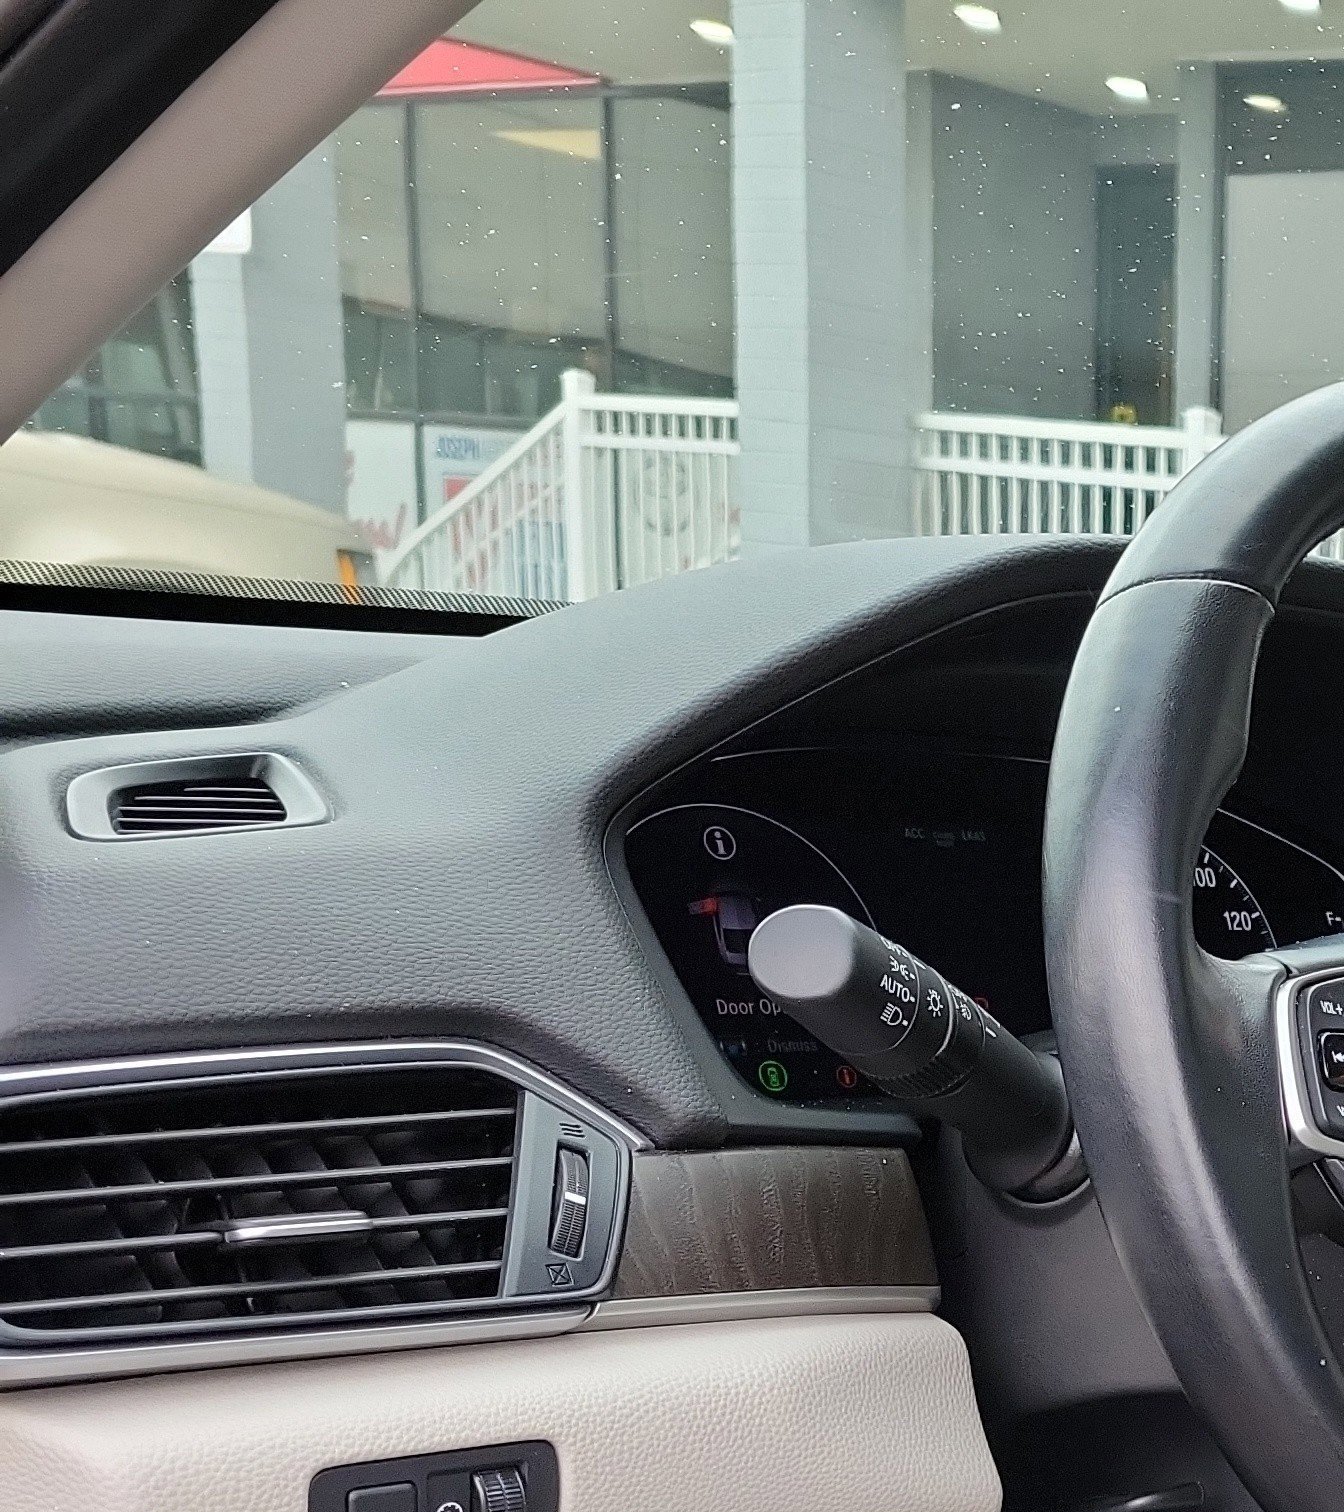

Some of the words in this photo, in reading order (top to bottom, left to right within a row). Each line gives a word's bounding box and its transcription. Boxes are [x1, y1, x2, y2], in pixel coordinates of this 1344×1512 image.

[1223, 910, 1252, 931] 120
[1326, 911, 1335, 926] F
[880, 974, 911, 1002] AUTO
[715, 998, 754, 1015] Door
[759, 998, 781, 1016] Op
[1320, 1000, 1343, 1016] VOL+
